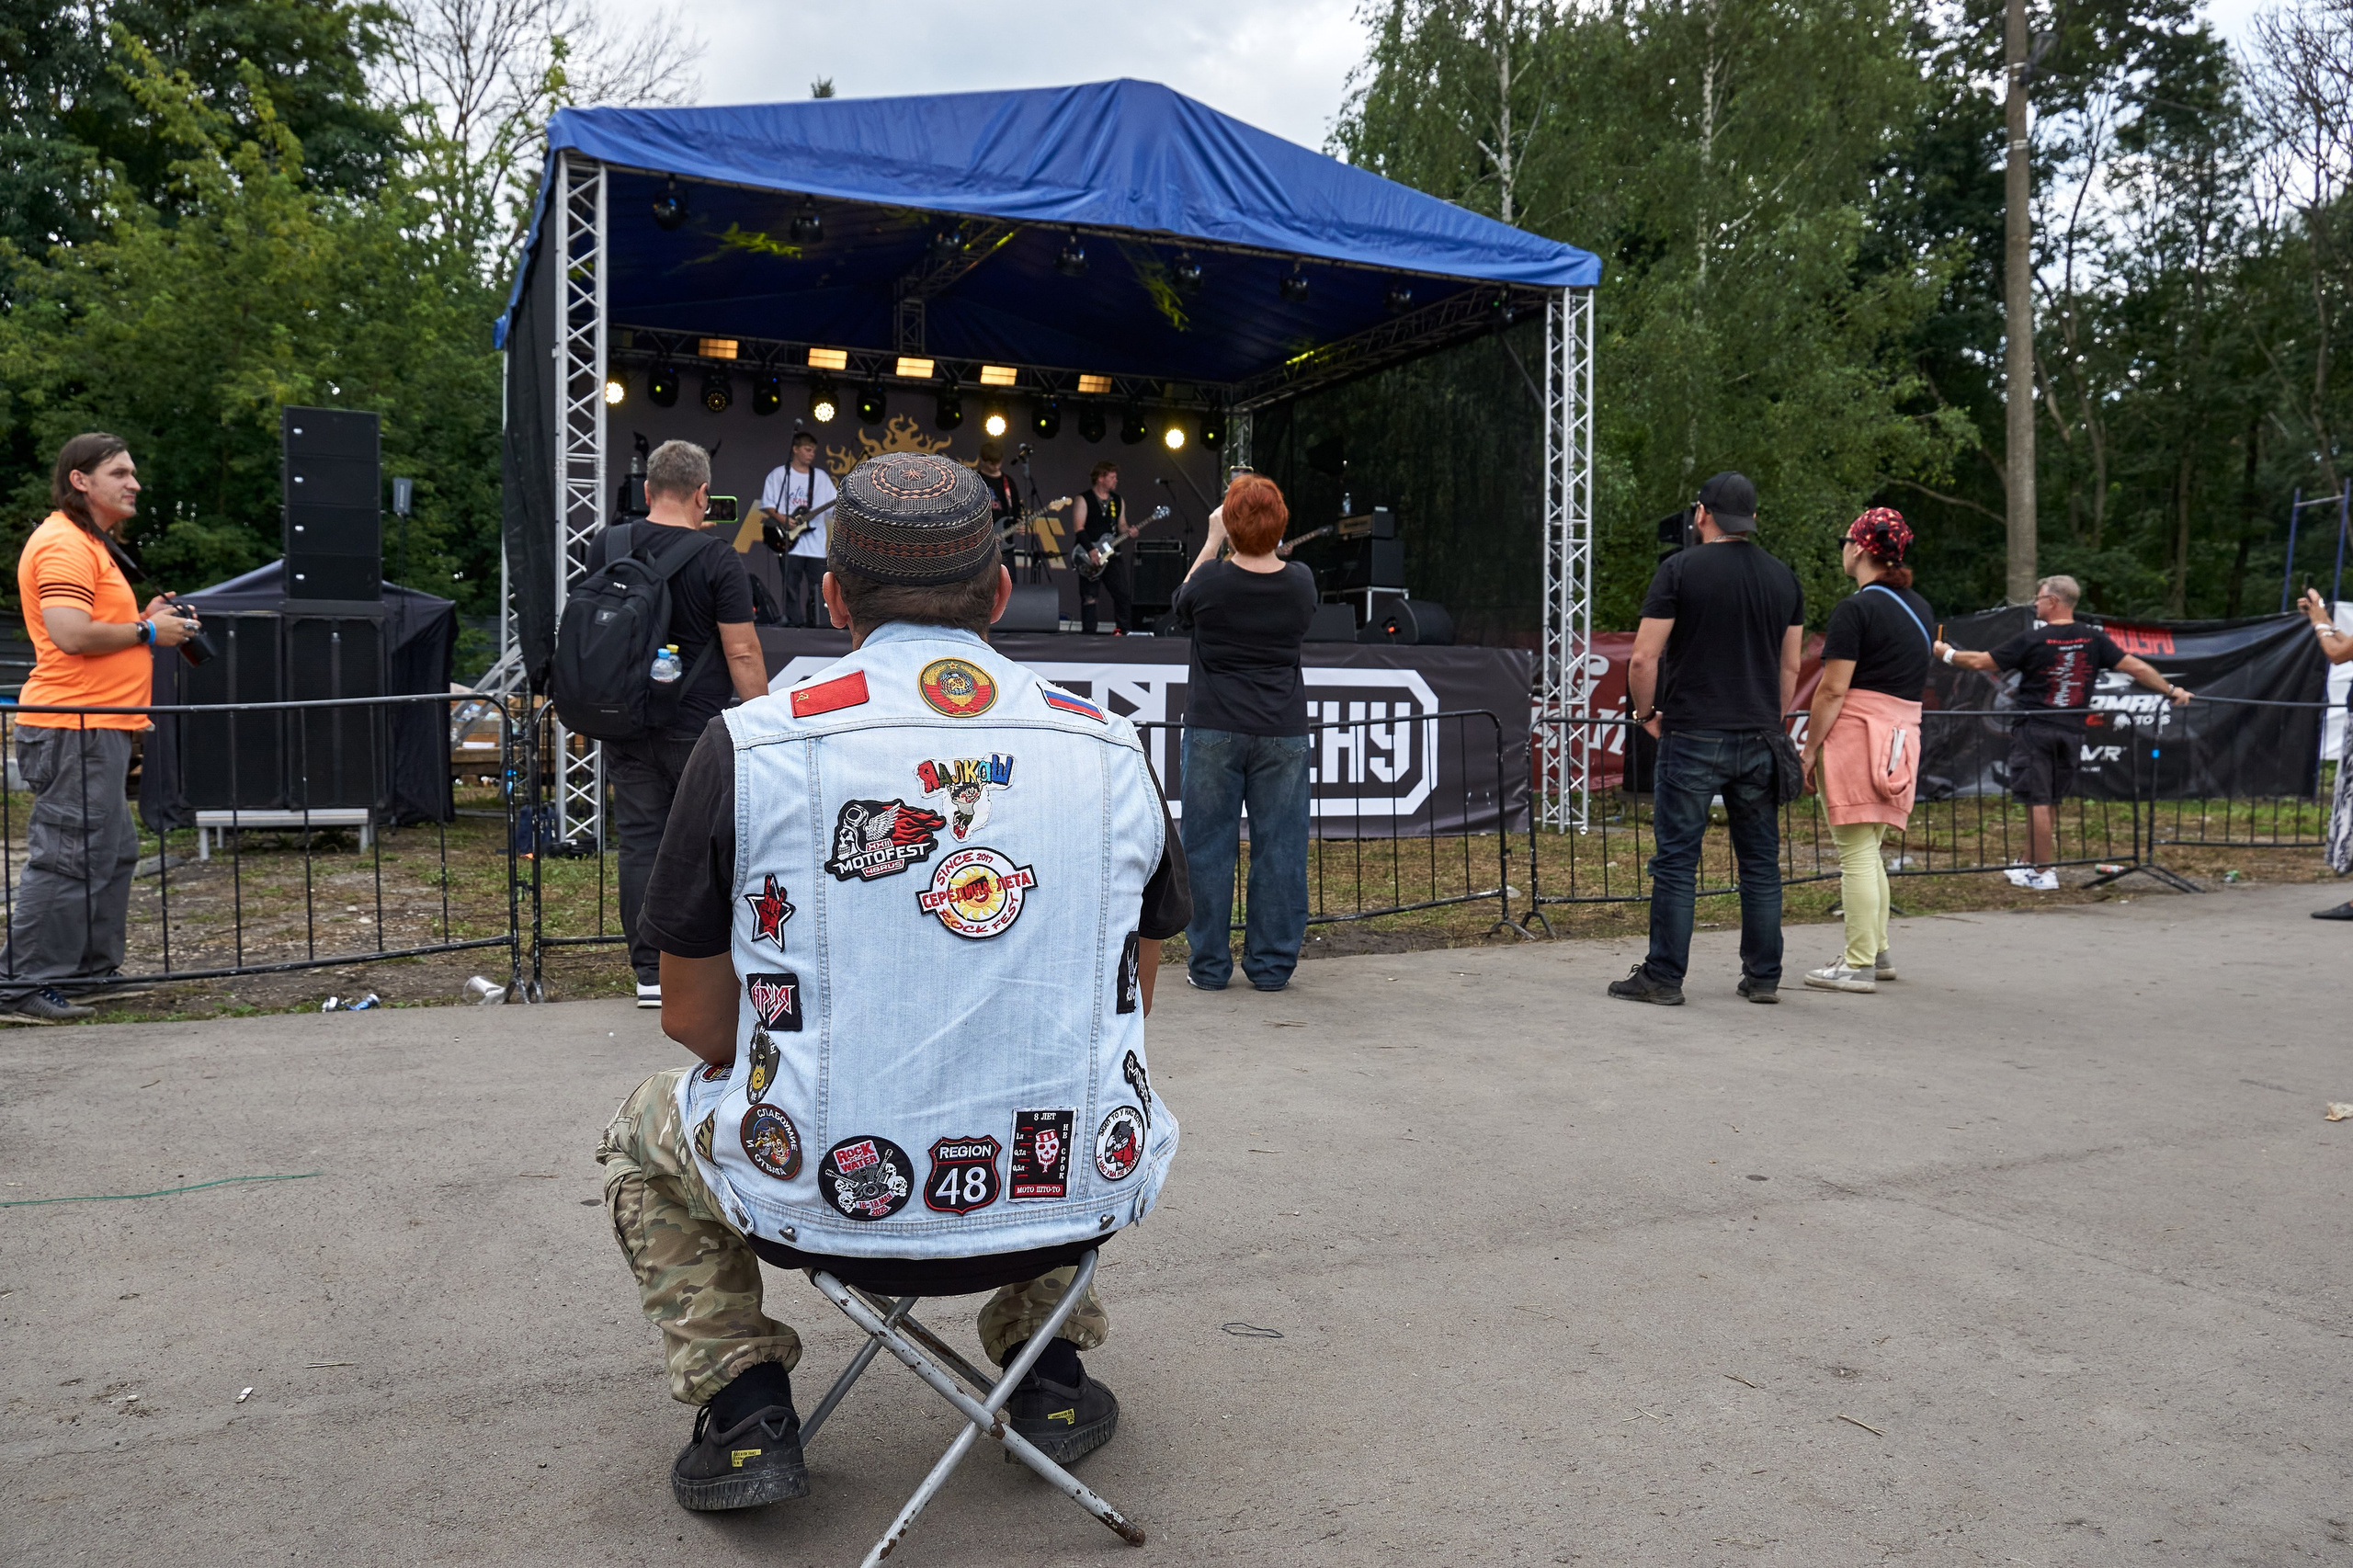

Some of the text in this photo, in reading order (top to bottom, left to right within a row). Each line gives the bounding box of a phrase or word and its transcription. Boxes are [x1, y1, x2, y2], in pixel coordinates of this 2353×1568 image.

[2089, 695, 2172, 712] OMAX
[833, 843, 930, 874] MOTOFEST
[864, 860, 904, 875] 48RUS
[937, 852, 994, 886] SINCE 2017
[922, 871, 1032, 908] СЕРЕДИНА ЛЕТА
[938, 892, 1019, 934] ROCK FEST
[751, 978, 796, 1028] АРИЯ
[1034, 1113, 1039, 1121] 8
[1111, 1112, 1119, 1120] ТО
[756, 1108, 798, 1152] СЛАБОУМИЕ
[1063, 1124, 1069, 1139] НЕ
[746, 1139, 756, 1148] И
[939, 1145, 992, 1158] REGION
[835, 1142, 875, 1164] ROCK
[754, 1153, 787, 1176] ОТВАГА
[840, 1155, 878, 1173] WATER
[1098, 1160, 1108, 1172] НАС
[1106, 1170, 1117, 1178] УМА
[936, 1166, 987, 1205] 48
[858, 1193, 892, 1209] 16-18 МАЯ
[871, 1206, 889, 1215] 2025
